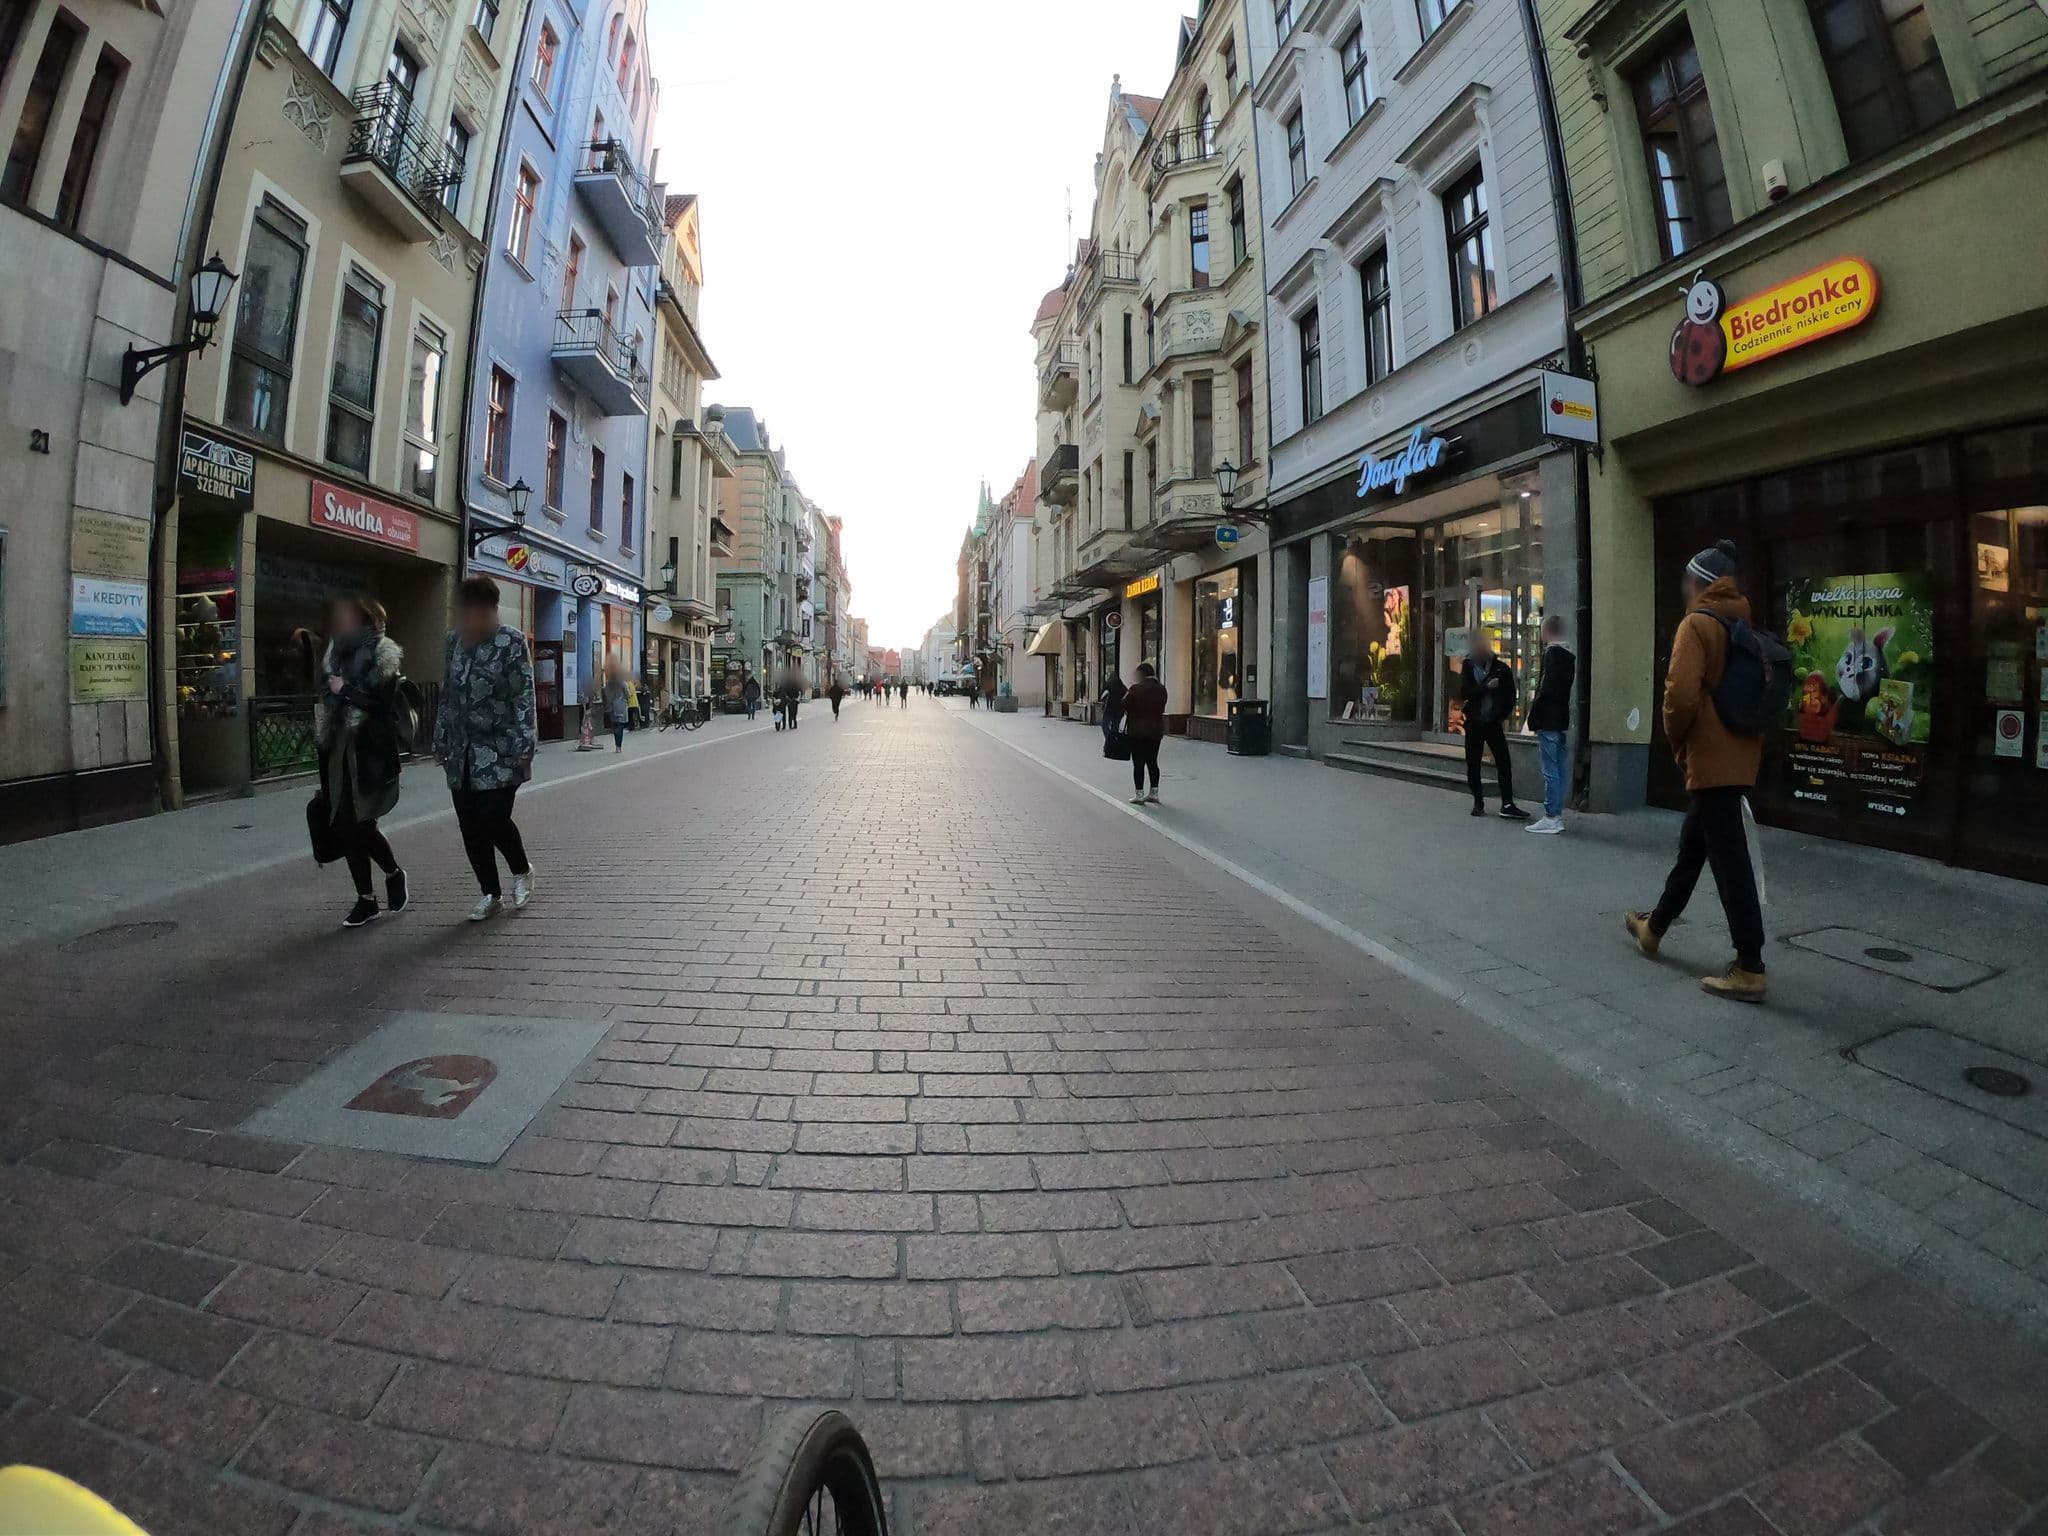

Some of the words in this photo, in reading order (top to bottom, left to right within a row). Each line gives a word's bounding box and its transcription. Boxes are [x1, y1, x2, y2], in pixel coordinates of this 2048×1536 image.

[1730, 273, 1860, 341] Biedronka
[1733, 324, 1793, 354] Codziennie
[1796, 310, 1830, 330] niskie
[1834, 298, 1862, 315] ceny
[30, 428, 50, 455] 21
[184, 455, 249, 488] APARTAMENTY
[1356, 424, 1441, 498] Douglas
[196, 475, 236, 500] SZEROKA
[93, 591, 143, 607] KREDYTY
[1811, 585, 1904, 603] wielkanocna
[1812, 603, 1903, 619] WYKLEJANKA
[85, 651, 136, 661] KANCELARIA
